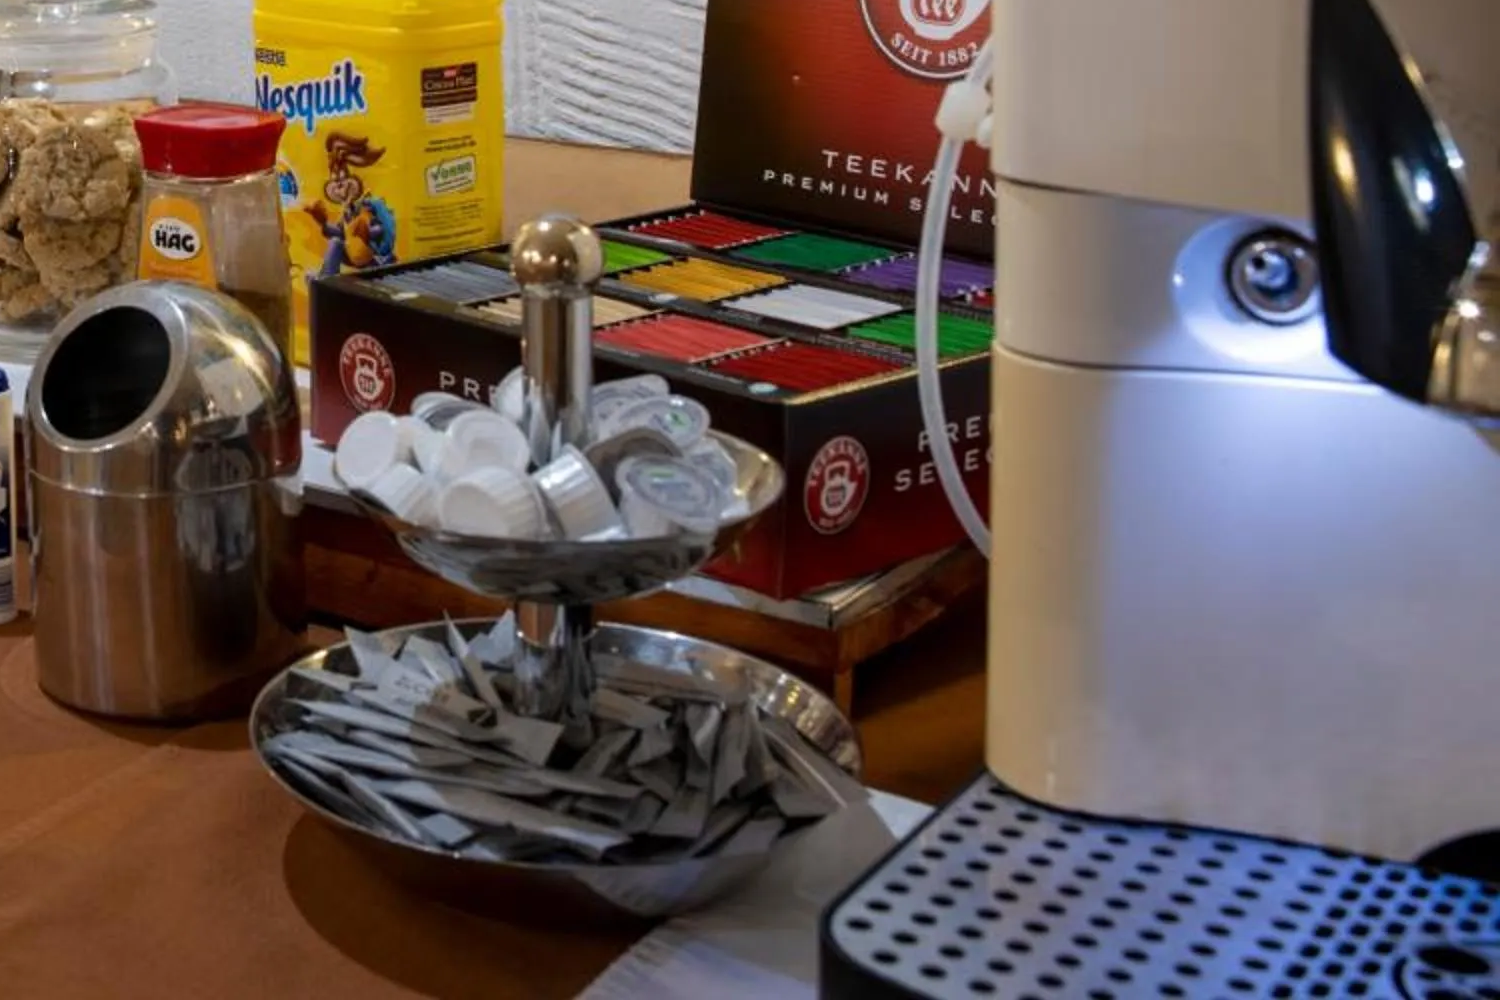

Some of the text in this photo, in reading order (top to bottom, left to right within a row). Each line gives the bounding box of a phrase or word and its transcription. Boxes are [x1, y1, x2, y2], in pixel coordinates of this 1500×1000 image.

[891, 32, 933, 64] SEIT
[255, 60, 365, 133] Nesquik
[762, 168, 998, 226] PREMIUM SLE
[155, 229, 195, 253] HAG
[893, 449, 993, 492] SEE
